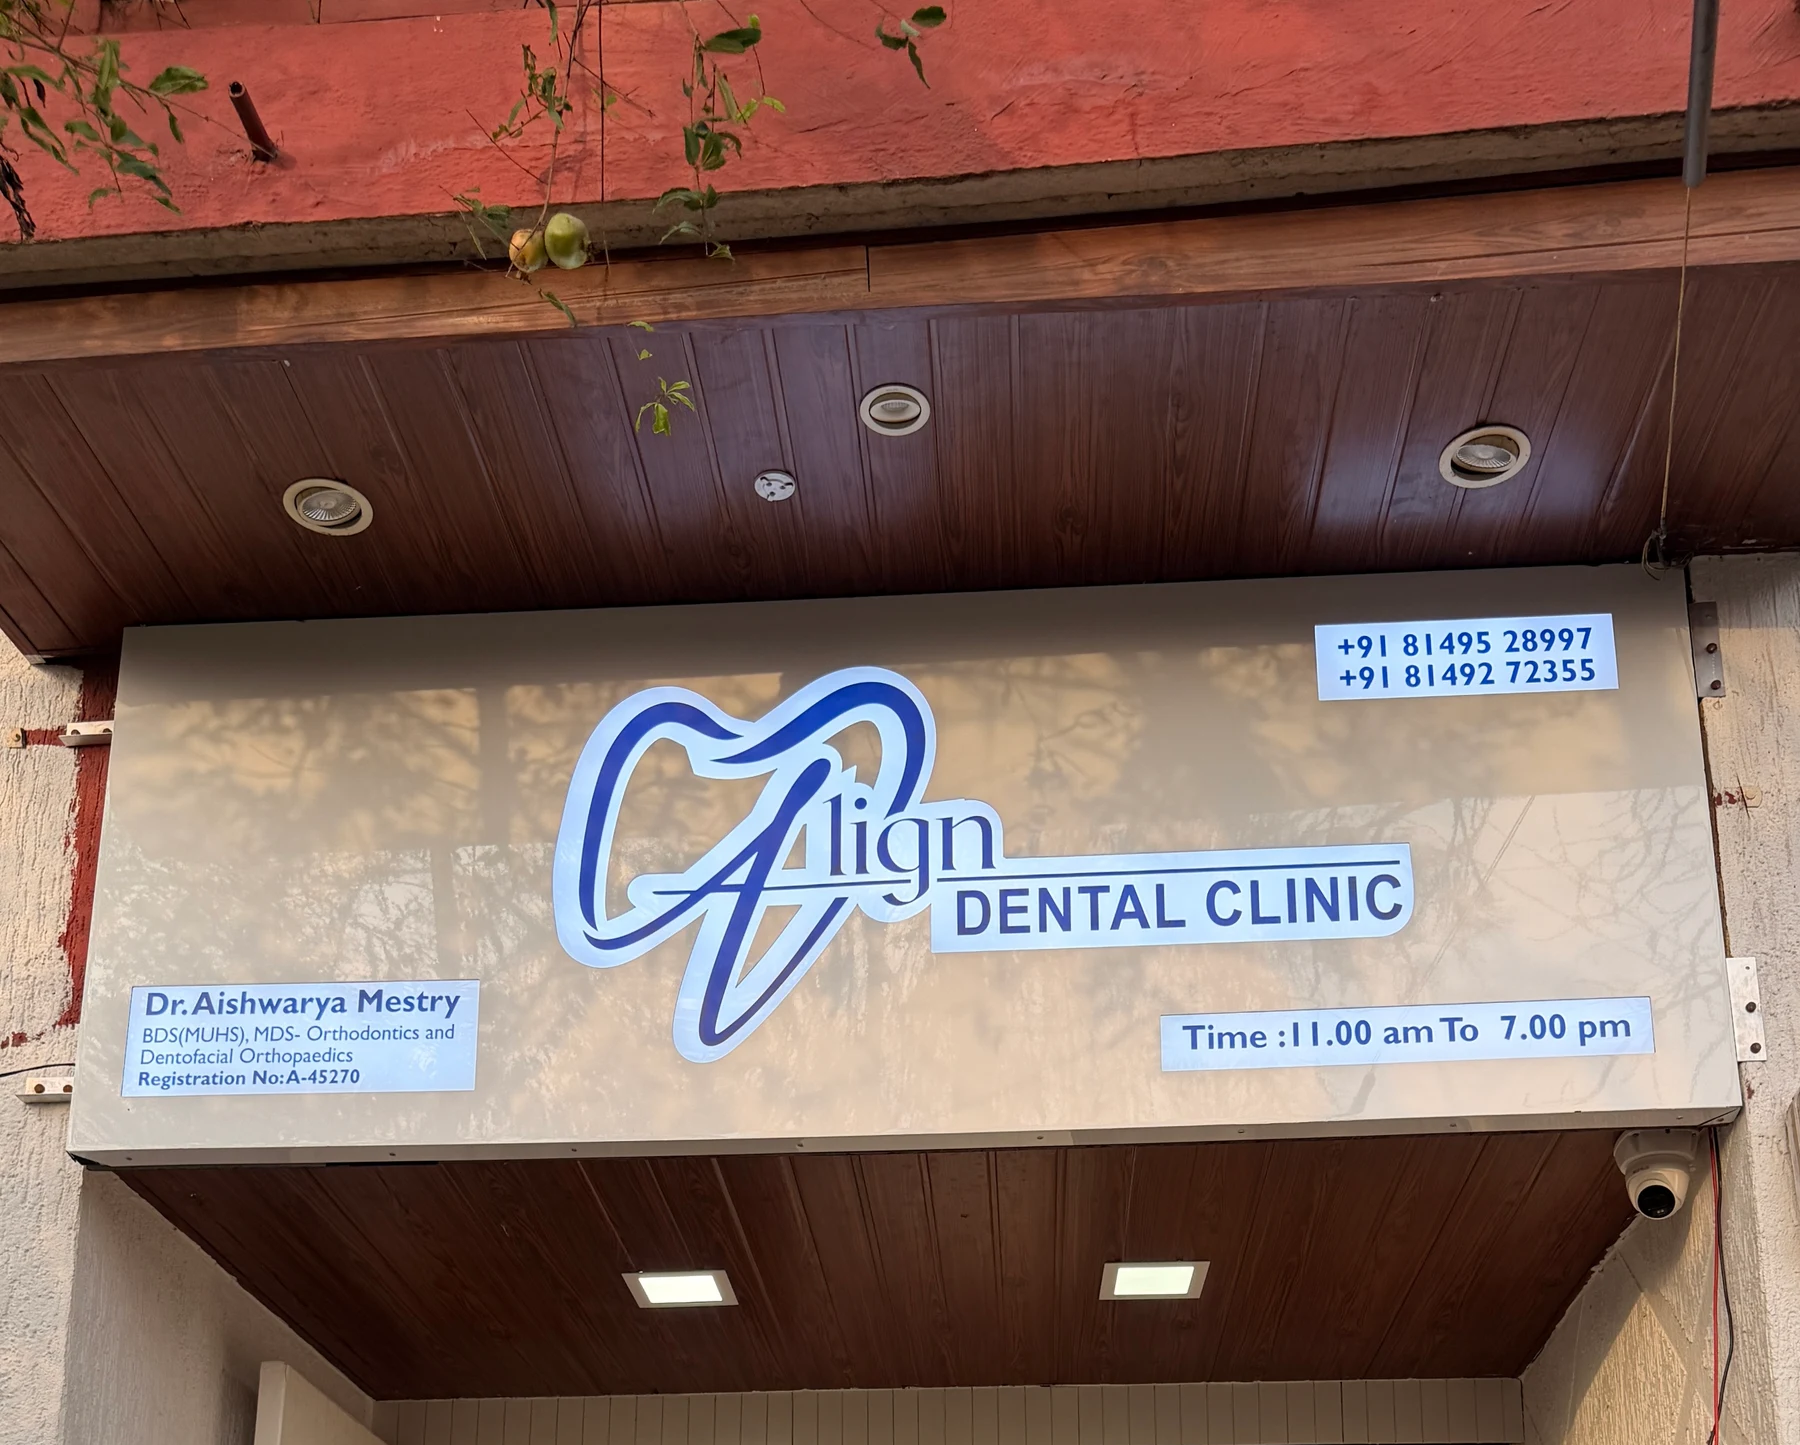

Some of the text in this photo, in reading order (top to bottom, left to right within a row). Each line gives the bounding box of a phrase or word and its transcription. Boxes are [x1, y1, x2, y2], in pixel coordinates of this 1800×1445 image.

[1338, 627, 1591, 658] +91 81495 28997
[1340, 659, 1595, 689] +91 81492 72355
[956, 874, 1404, 936] DENTAL CLINIC
[358, 989, 460, 1019] Mestry
[142, 1024, 455, 1048] BDS(MUHS), MDS- Orthodontics and
[1182, 1024, 1268, 1050] Time
[1500, 1014, 1567, 1041] 7.00
[1579, 1018, 1632, 1047] pm
[141, 1047, 353, 1067] Dentofacial Orthopaedics
[138, 1072, 246, 1091] Registration
